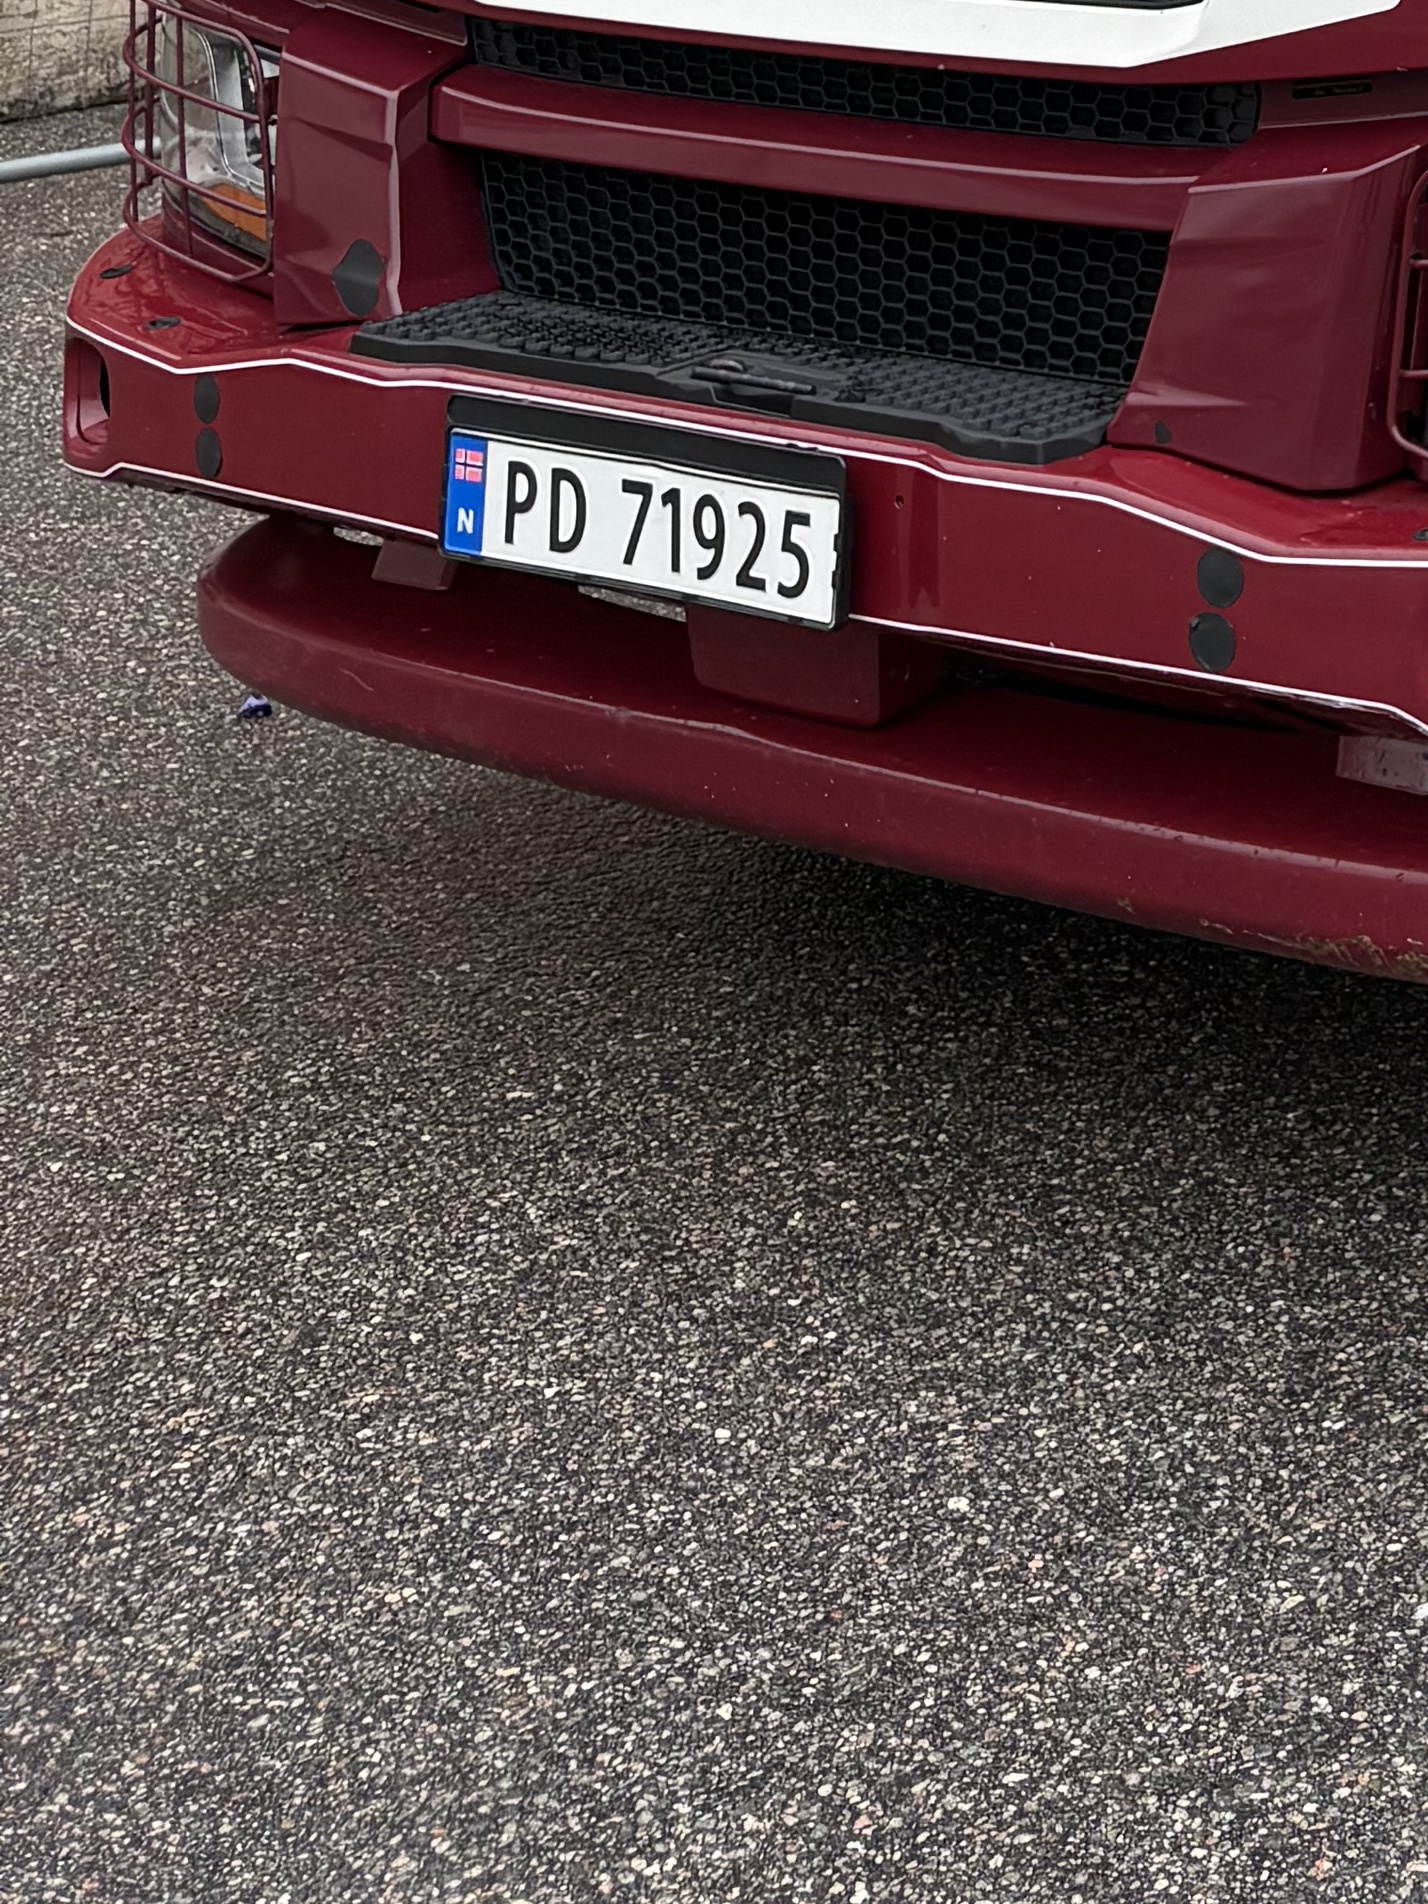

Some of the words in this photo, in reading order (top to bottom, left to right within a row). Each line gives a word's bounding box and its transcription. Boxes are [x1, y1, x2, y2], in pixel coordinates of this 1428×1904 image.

[457, 507, 474, 534] N
[505, 460, 587, 553] PD
[621, 479, 811, 598] 71925
